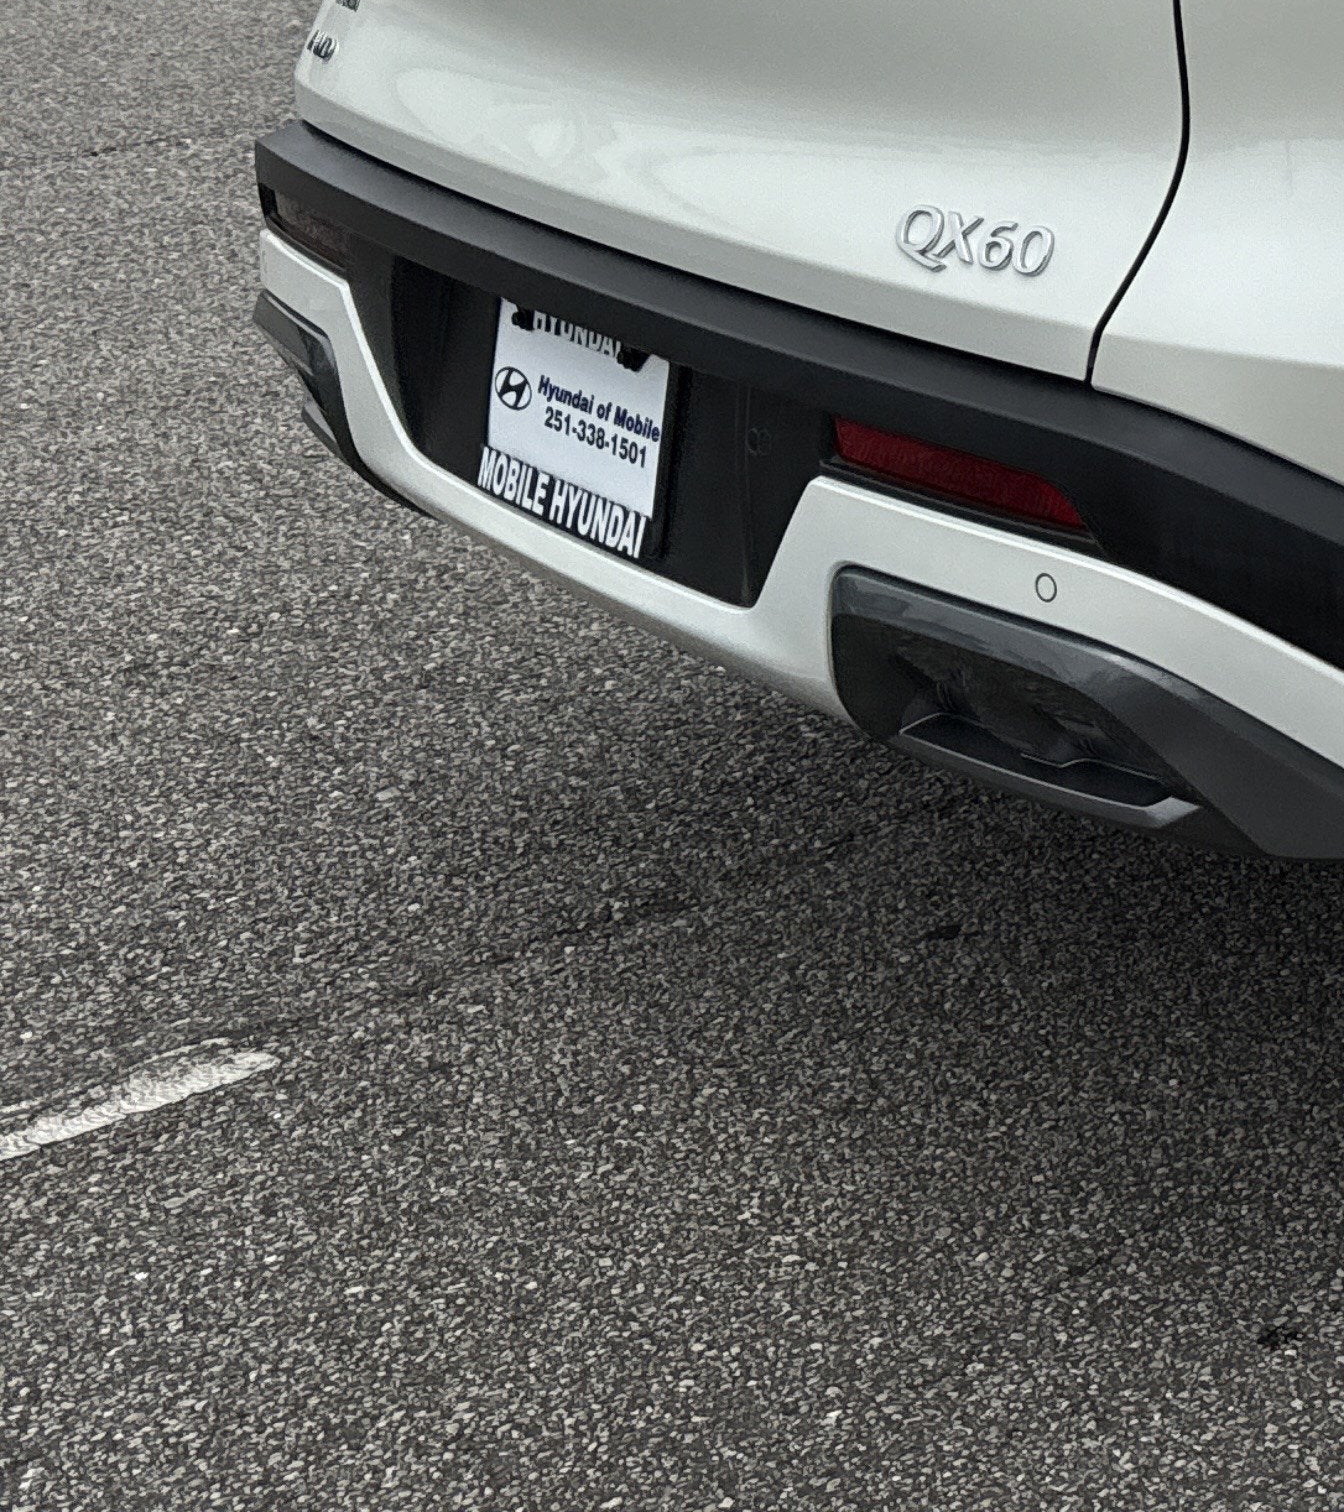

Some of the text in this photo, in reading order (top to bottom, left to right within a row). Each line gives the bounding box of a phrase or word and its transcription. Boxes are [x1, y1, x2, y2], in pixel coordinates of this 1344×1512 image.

[895, 203, 1055, 278] QX60
[537, 375, 660, 442] Hyundai of Mobile
[544, 407, 647, 468] 251-338-1501
[477, 446, 649, 559] MOBILE HYUNDAI
